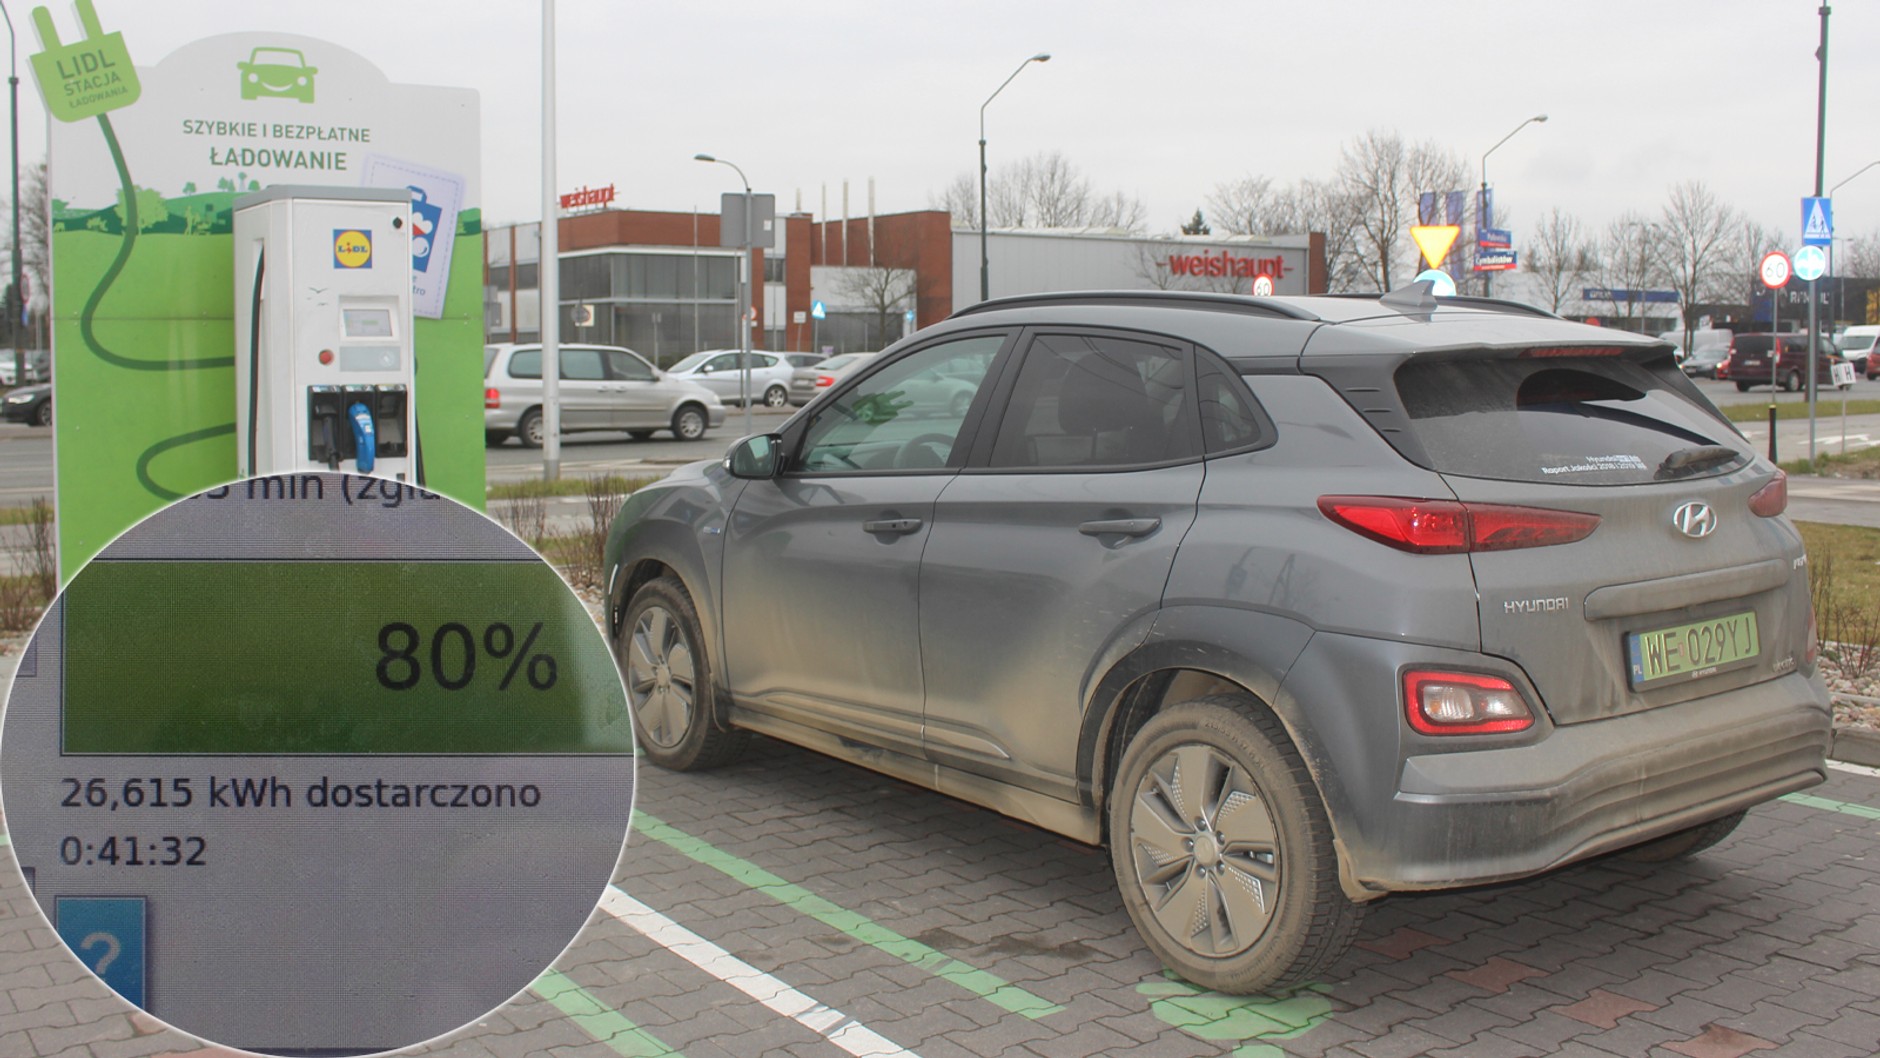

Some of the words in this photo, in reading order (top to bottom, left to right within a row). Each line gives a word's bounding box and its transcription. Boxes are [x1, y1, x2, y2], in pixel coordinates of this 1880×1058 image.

[56, 49, 115, 79] LIDL
[64, 71, 121, 96] STACJA
[69, 86, 128, 108] ŁADOWANIA
[183, 119, 257, 137] SZYBKIE
[262, 124, 267, 137] I
[272, 124, 370, 142] BEZPŁATNE
[209, 147, 347, 170] ŁADOWANIE
[1766, 263, 1785, 278] 60
[248, 475, 324, 500] min
[1504, 597, 1569, 613] HYUNDAI
[376, 621, 558, 691] 80%
[1644, 630, 1681, 676] WE
[1686, 616, 1752, 667] 029YJ
[61, 778, 193, 811] 26,615
[209, 776, 292, 807] kWh
[306, 776, 542, 807] dostarczono
[60, 836, 207, 866] 0:41:32
